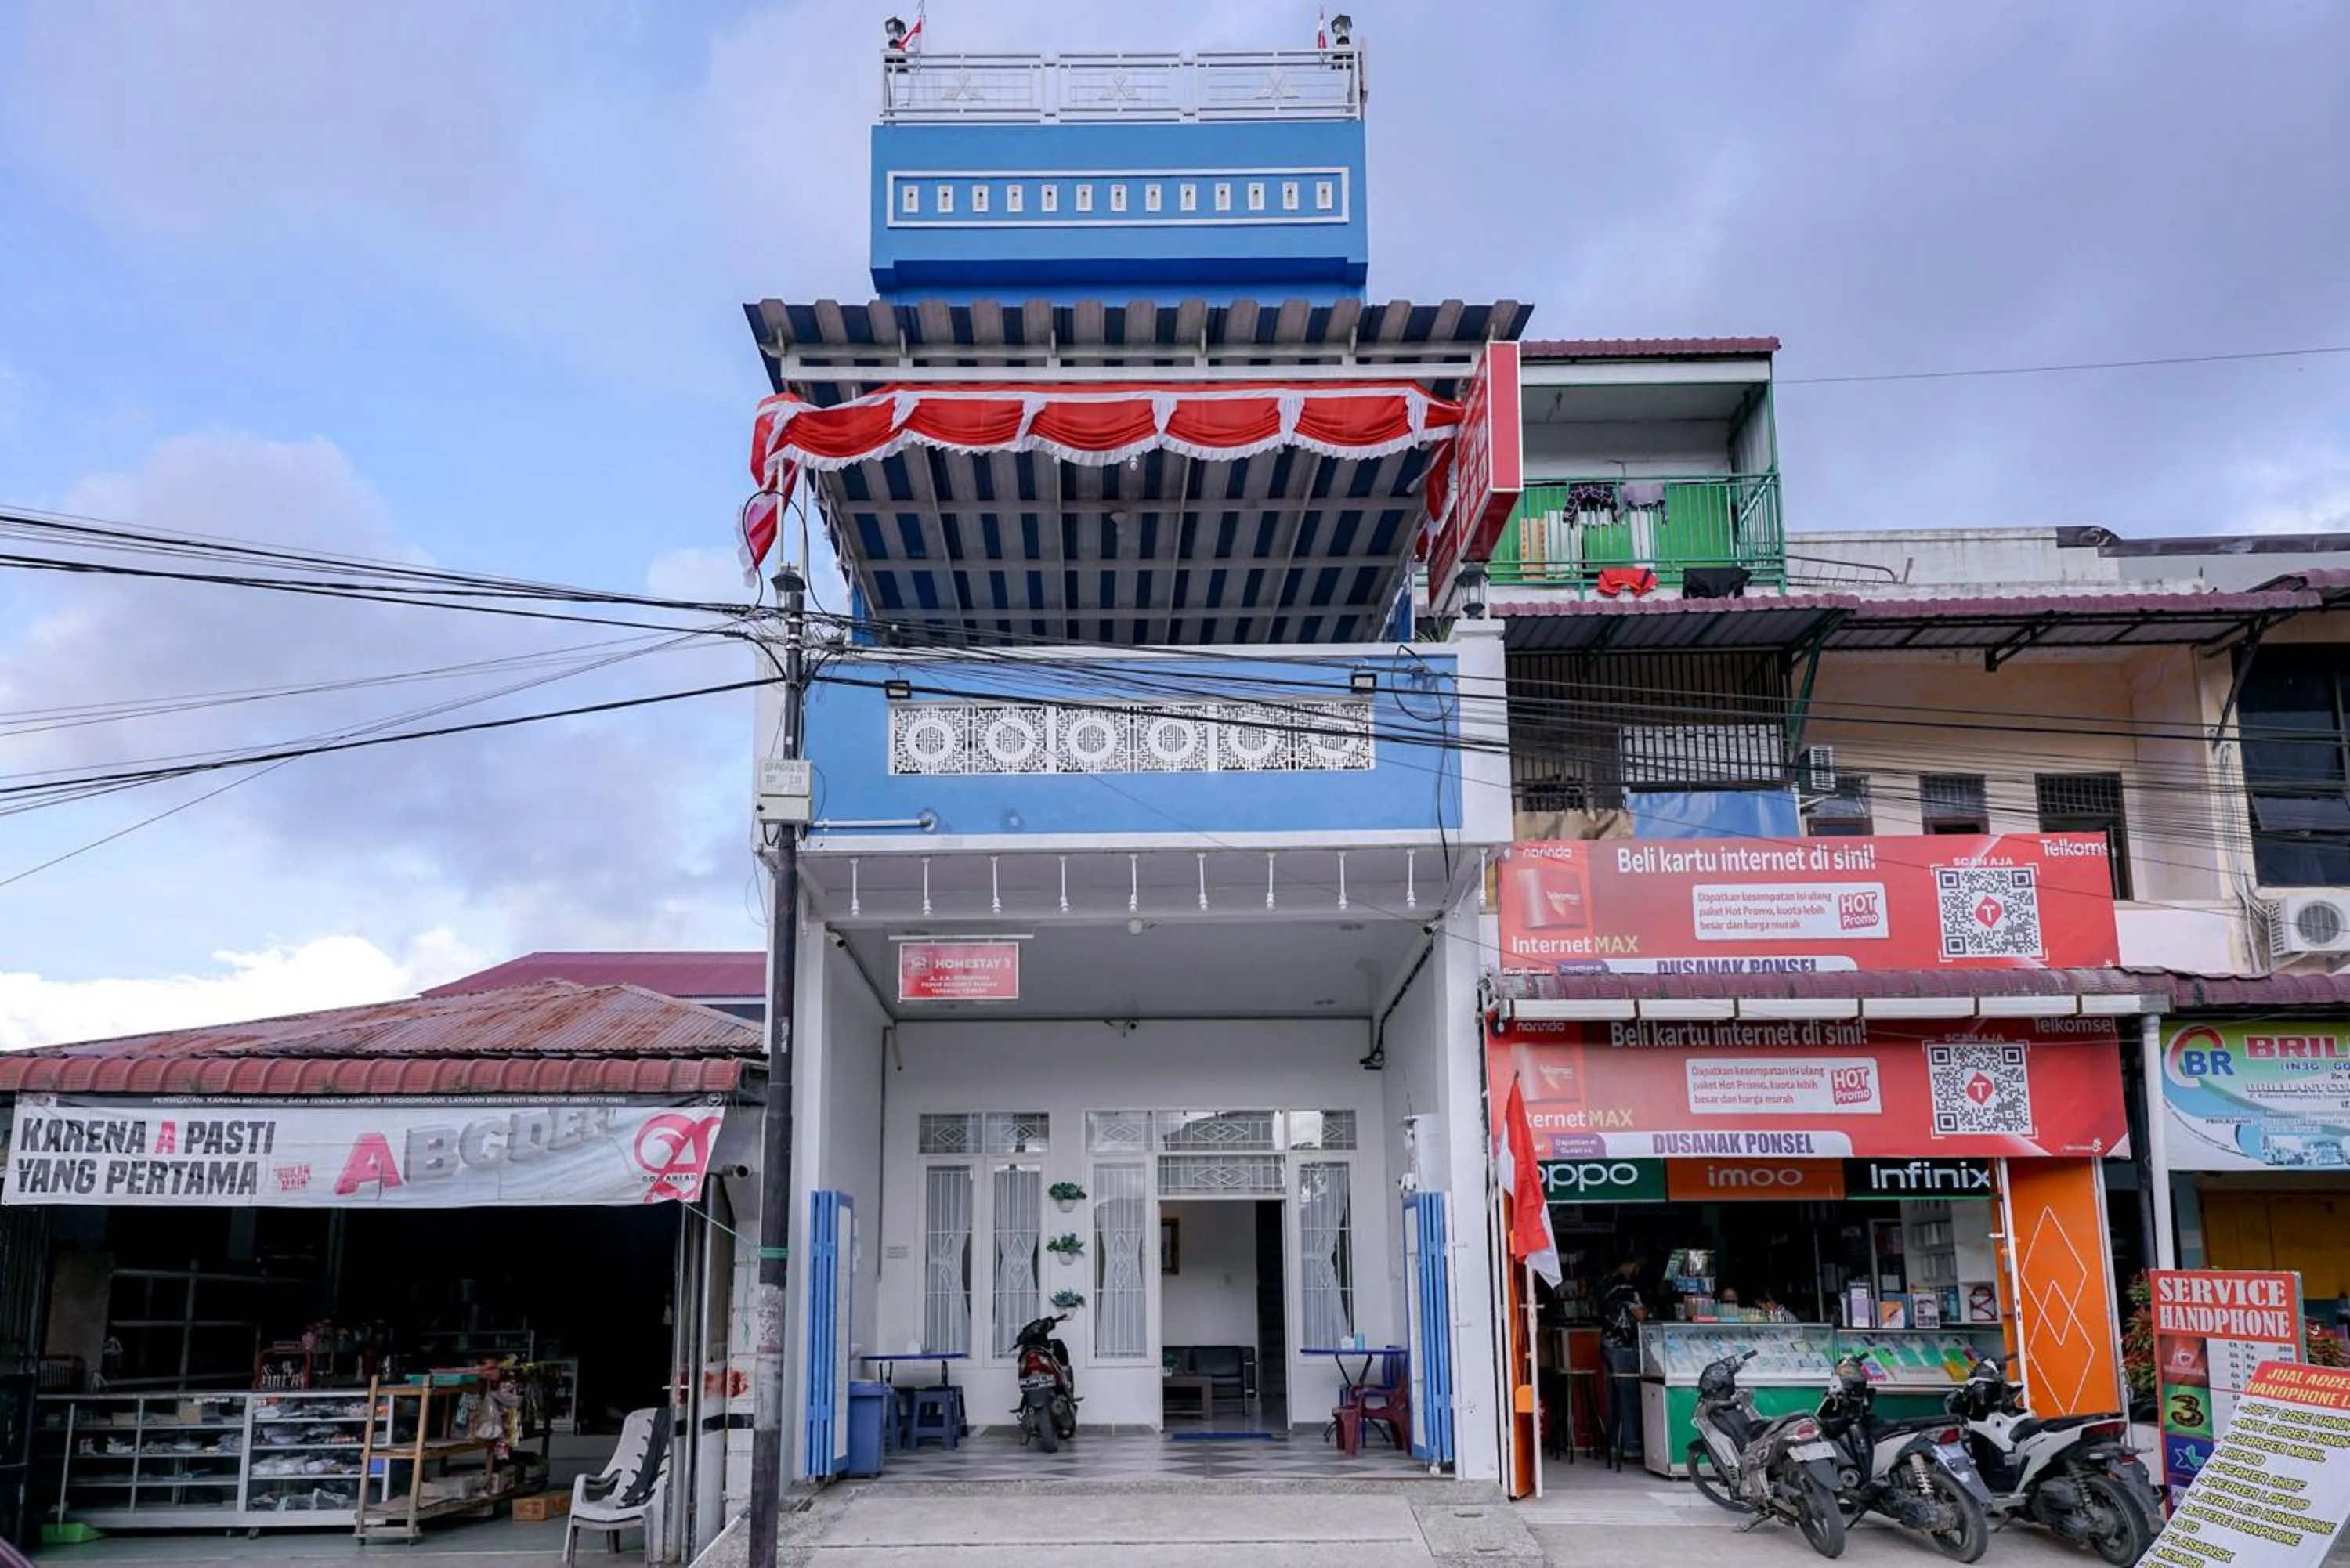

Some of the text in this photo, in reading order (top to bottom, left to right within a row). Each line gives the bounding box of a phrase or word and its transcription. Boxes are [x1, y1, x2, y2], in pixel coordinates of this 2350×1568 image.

[1618, 844, 1876, 873] Beli kartu internet di sini!
[1990, 857, 2014, 866] AJA
[1841, 893, 1877, 914] HOT
[1726, 920, 1744, 930] dan
[1843, 914, 1878, 926] Promo
[935, 958, 1000, 970] HOMESTAY
[1611, 1019, 1868, 1047] Beli kartu internet di sini!
[1980, 1033, 2005, 1042] AJA
[2244, 1035, 2350, 1059] BRIL
[2184, 1050, 2234, 1076] BR
[1833, 1067, 1869, 1089] HOT
[1835, 1089, 1871, 1103] Promo
[20, 1118, 276, 1154] KARENA A PASTI
[1653, 1133, 1815, 1154] DUSANAK PONSEL
[16, 1158, 258, 1194] YANG PERTAMA
[1708, 1165, 1802, 1187] imoo
[1870, 1162, 1990, 1190] Infinix
[2157, 1277, 2287, 1307] SERVICE
[2159, 1305, 2291, 1339] HANDPHONE
[2266, 1368, 2304, 1385] JUAL
[2247, 1382, 2341, 1406] HANDPHONE
[2233, 1501, 2262, 1518] LCD
